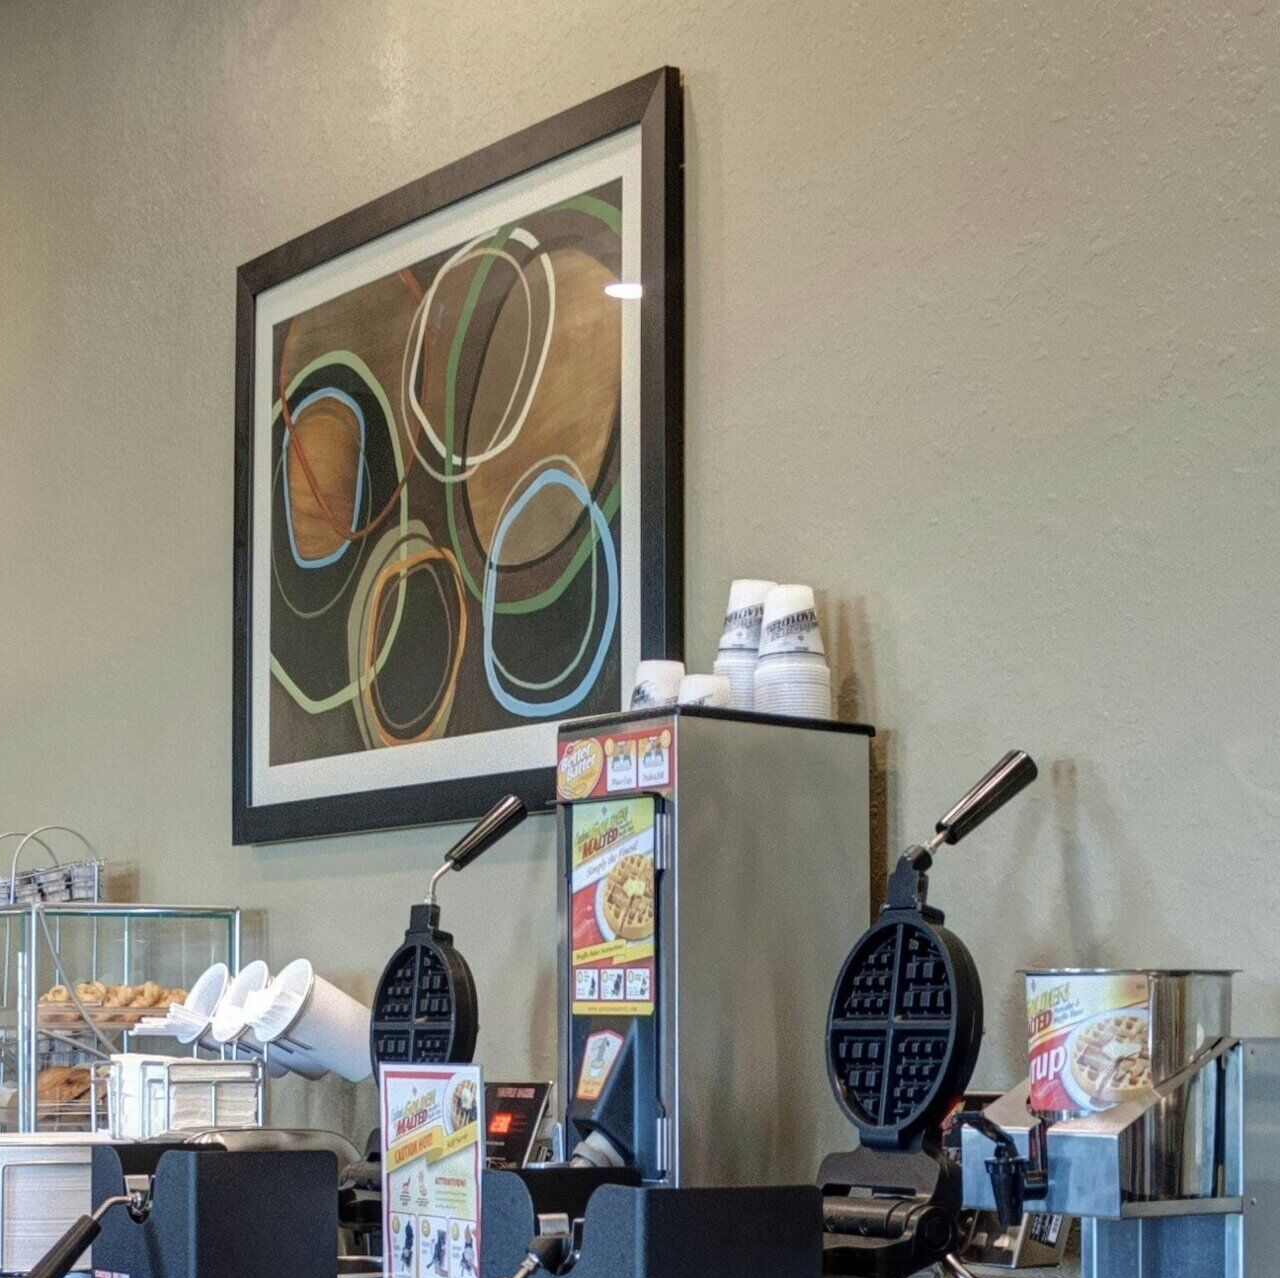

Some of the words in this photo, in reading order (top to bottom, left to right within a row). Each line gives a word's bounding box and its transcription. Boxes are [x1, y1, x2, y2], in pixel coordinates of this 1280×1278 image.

[561, 742, 593, 771] Better
[566, 755, 596, 783] Batter
[582, 825, 619, 860] MALTED
[1029, 1046, 1067, 1085] rup
[396, 1108, 429, 1138] MALTED
[394, 1139, 418, 1164] CAUTION
